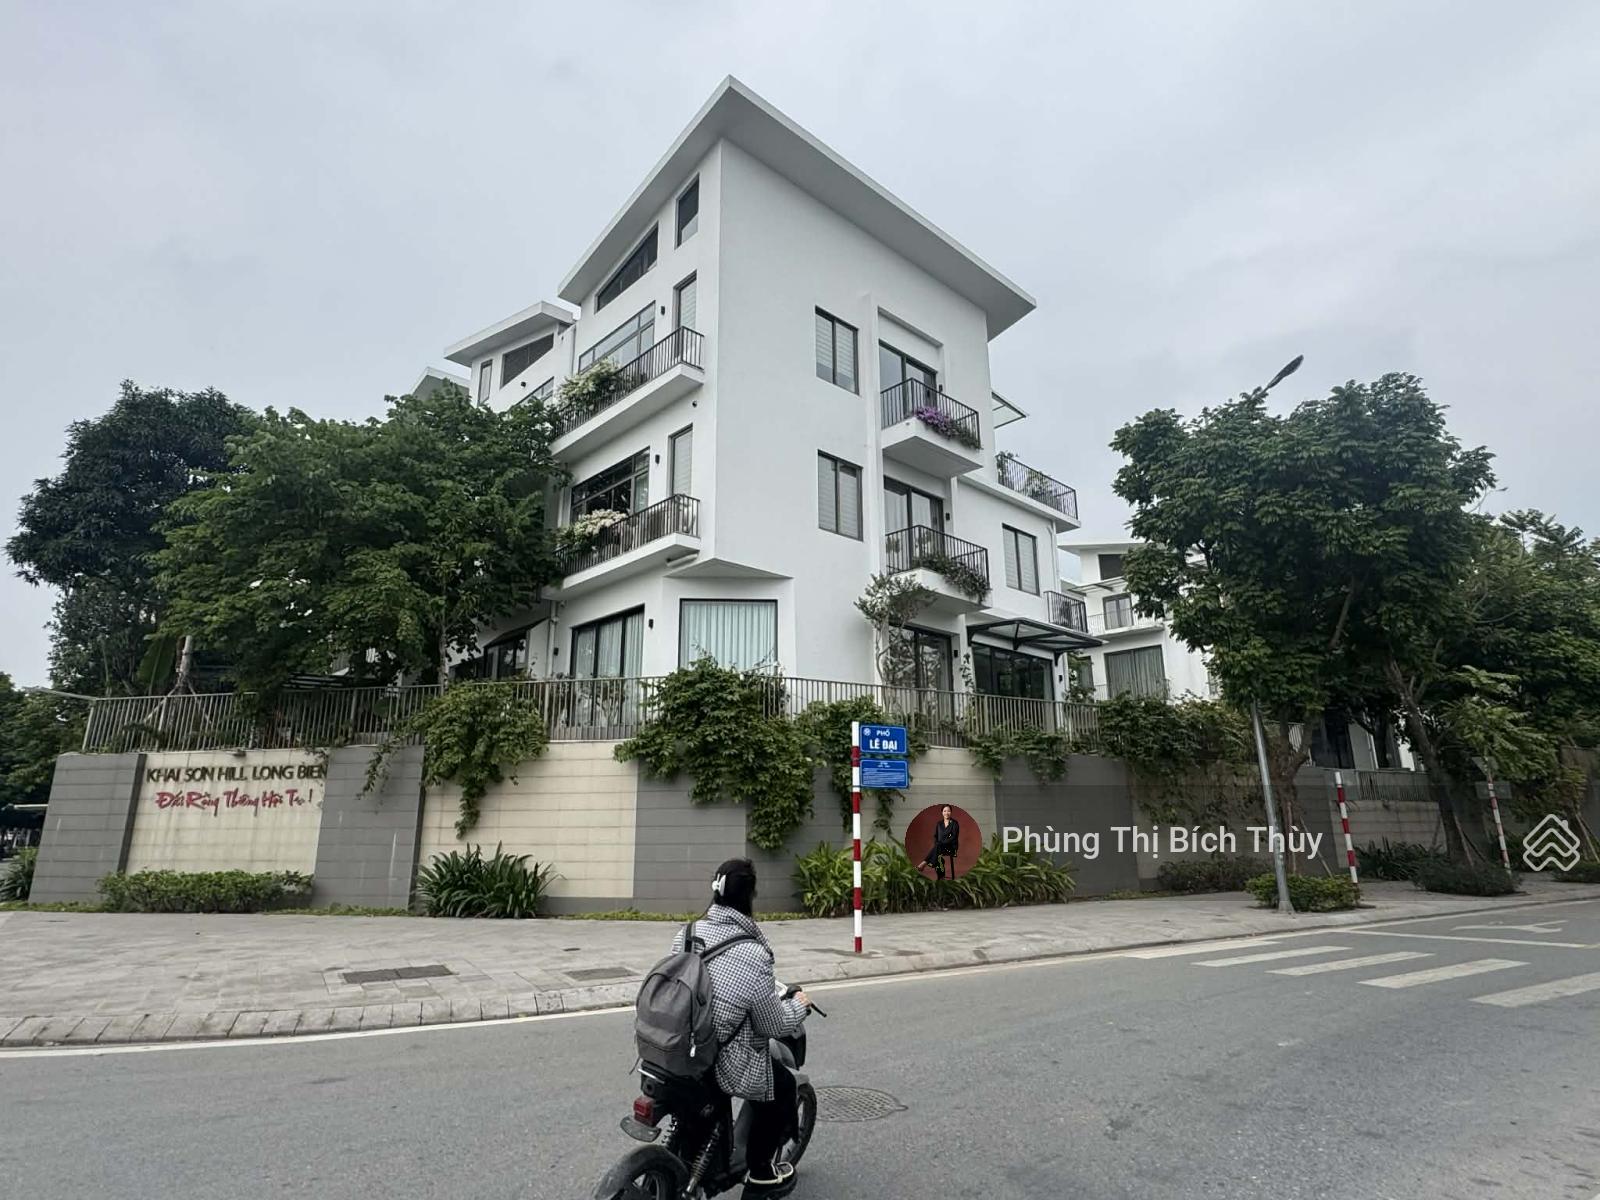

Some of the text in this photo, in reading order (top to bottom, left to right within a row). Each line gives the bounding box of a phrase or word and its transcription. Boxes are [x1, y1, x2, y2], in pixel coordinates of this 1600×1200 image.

[869, 737, 881, 750] LÊ
[146, 768, 181, 783] KHAI
[217, 766, 247, 781] HILL
[252, 765, 294, 780] LONG
